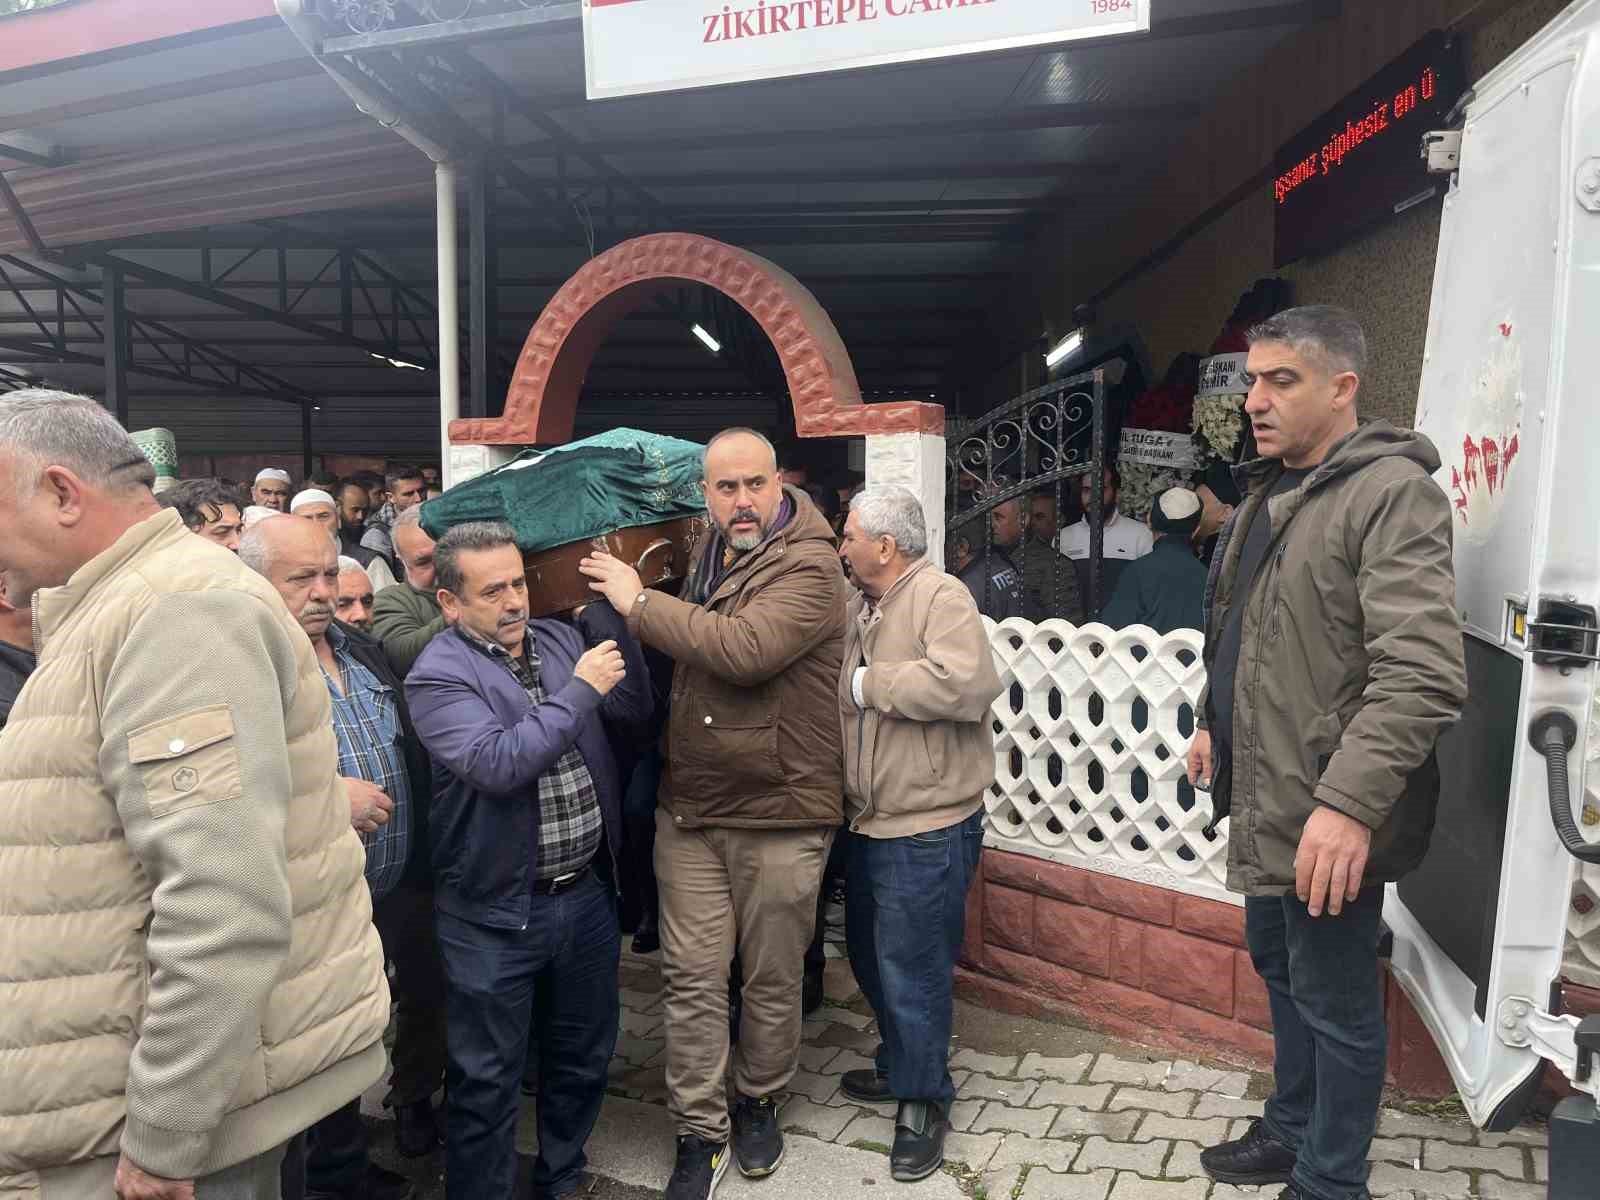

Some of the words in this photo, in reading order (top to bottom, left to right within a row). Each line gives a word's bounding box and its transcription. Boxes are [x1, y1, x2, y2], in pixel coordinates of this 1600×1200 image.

[702, 0, 878, 43] ZİKİRTEPE
[1090, 0, 1133, 14] 1984
[1321, 101, 1388, 175] şüphesiz
[1394, 84, 1416, 119] en
